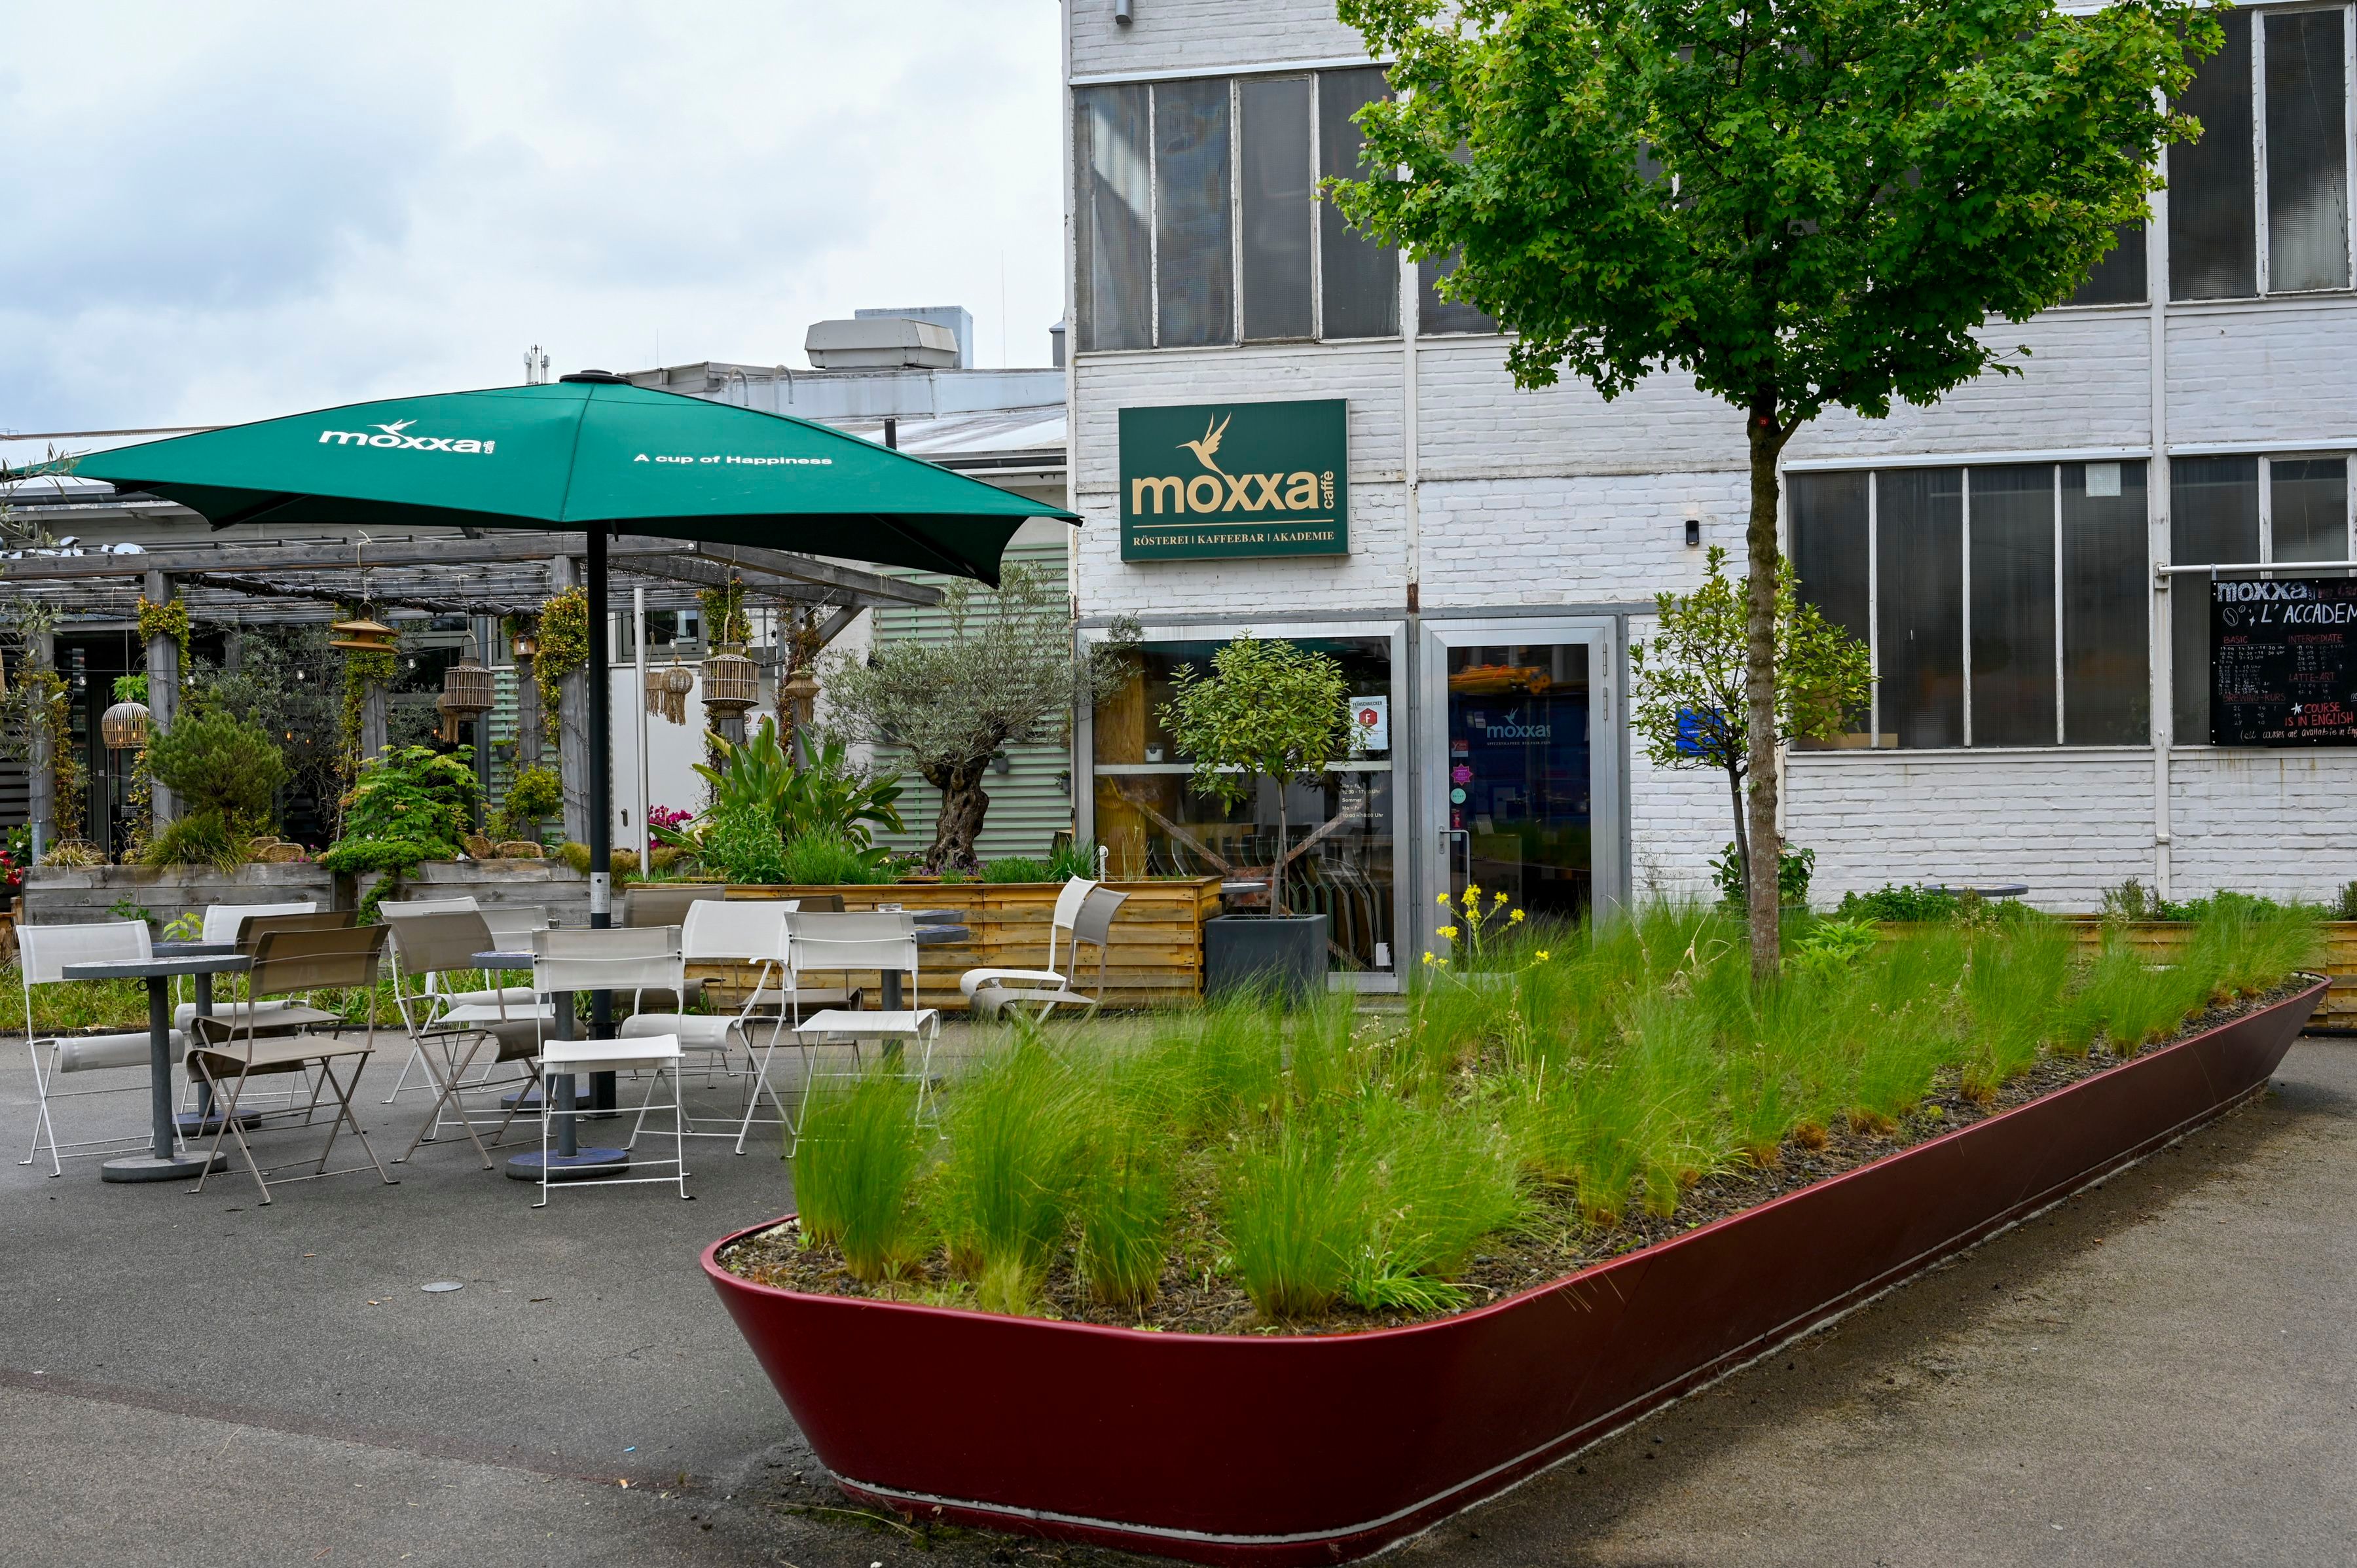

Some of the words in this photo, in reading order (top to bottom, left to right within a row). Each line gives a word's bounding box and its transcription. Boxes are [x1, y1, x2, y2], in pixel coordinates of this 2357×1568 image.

[318, 430, 482, 454] moxxa
[726, 456, 832, 465] Happiness
[1132, 471, 1319, 515] moxxa
[1320, 471, 1334, 509] caffè
[1133, 534, 1188, 545] RÖSTEREI
[1197, 534, 1264, 544] KAFFEEBAR
[1273, 531, 1334, 541] AKADEMIE
[2218, 582, 2308, 602] moxxa
[2288, 634, 2343, 643] INTERMEDIATE
[2289, 672, 2335, 682] LATTE-ART
[2304, 702, 2341, 714] COURSE
[1365, 714, 1371, 723] F
[2285, 717, 2293, 727] IS
[2298, 716, 2308, 726] IN
[2312, 712, 2354, 726] ENGLISH
[1487, 725, 1546, 738] moxxa
